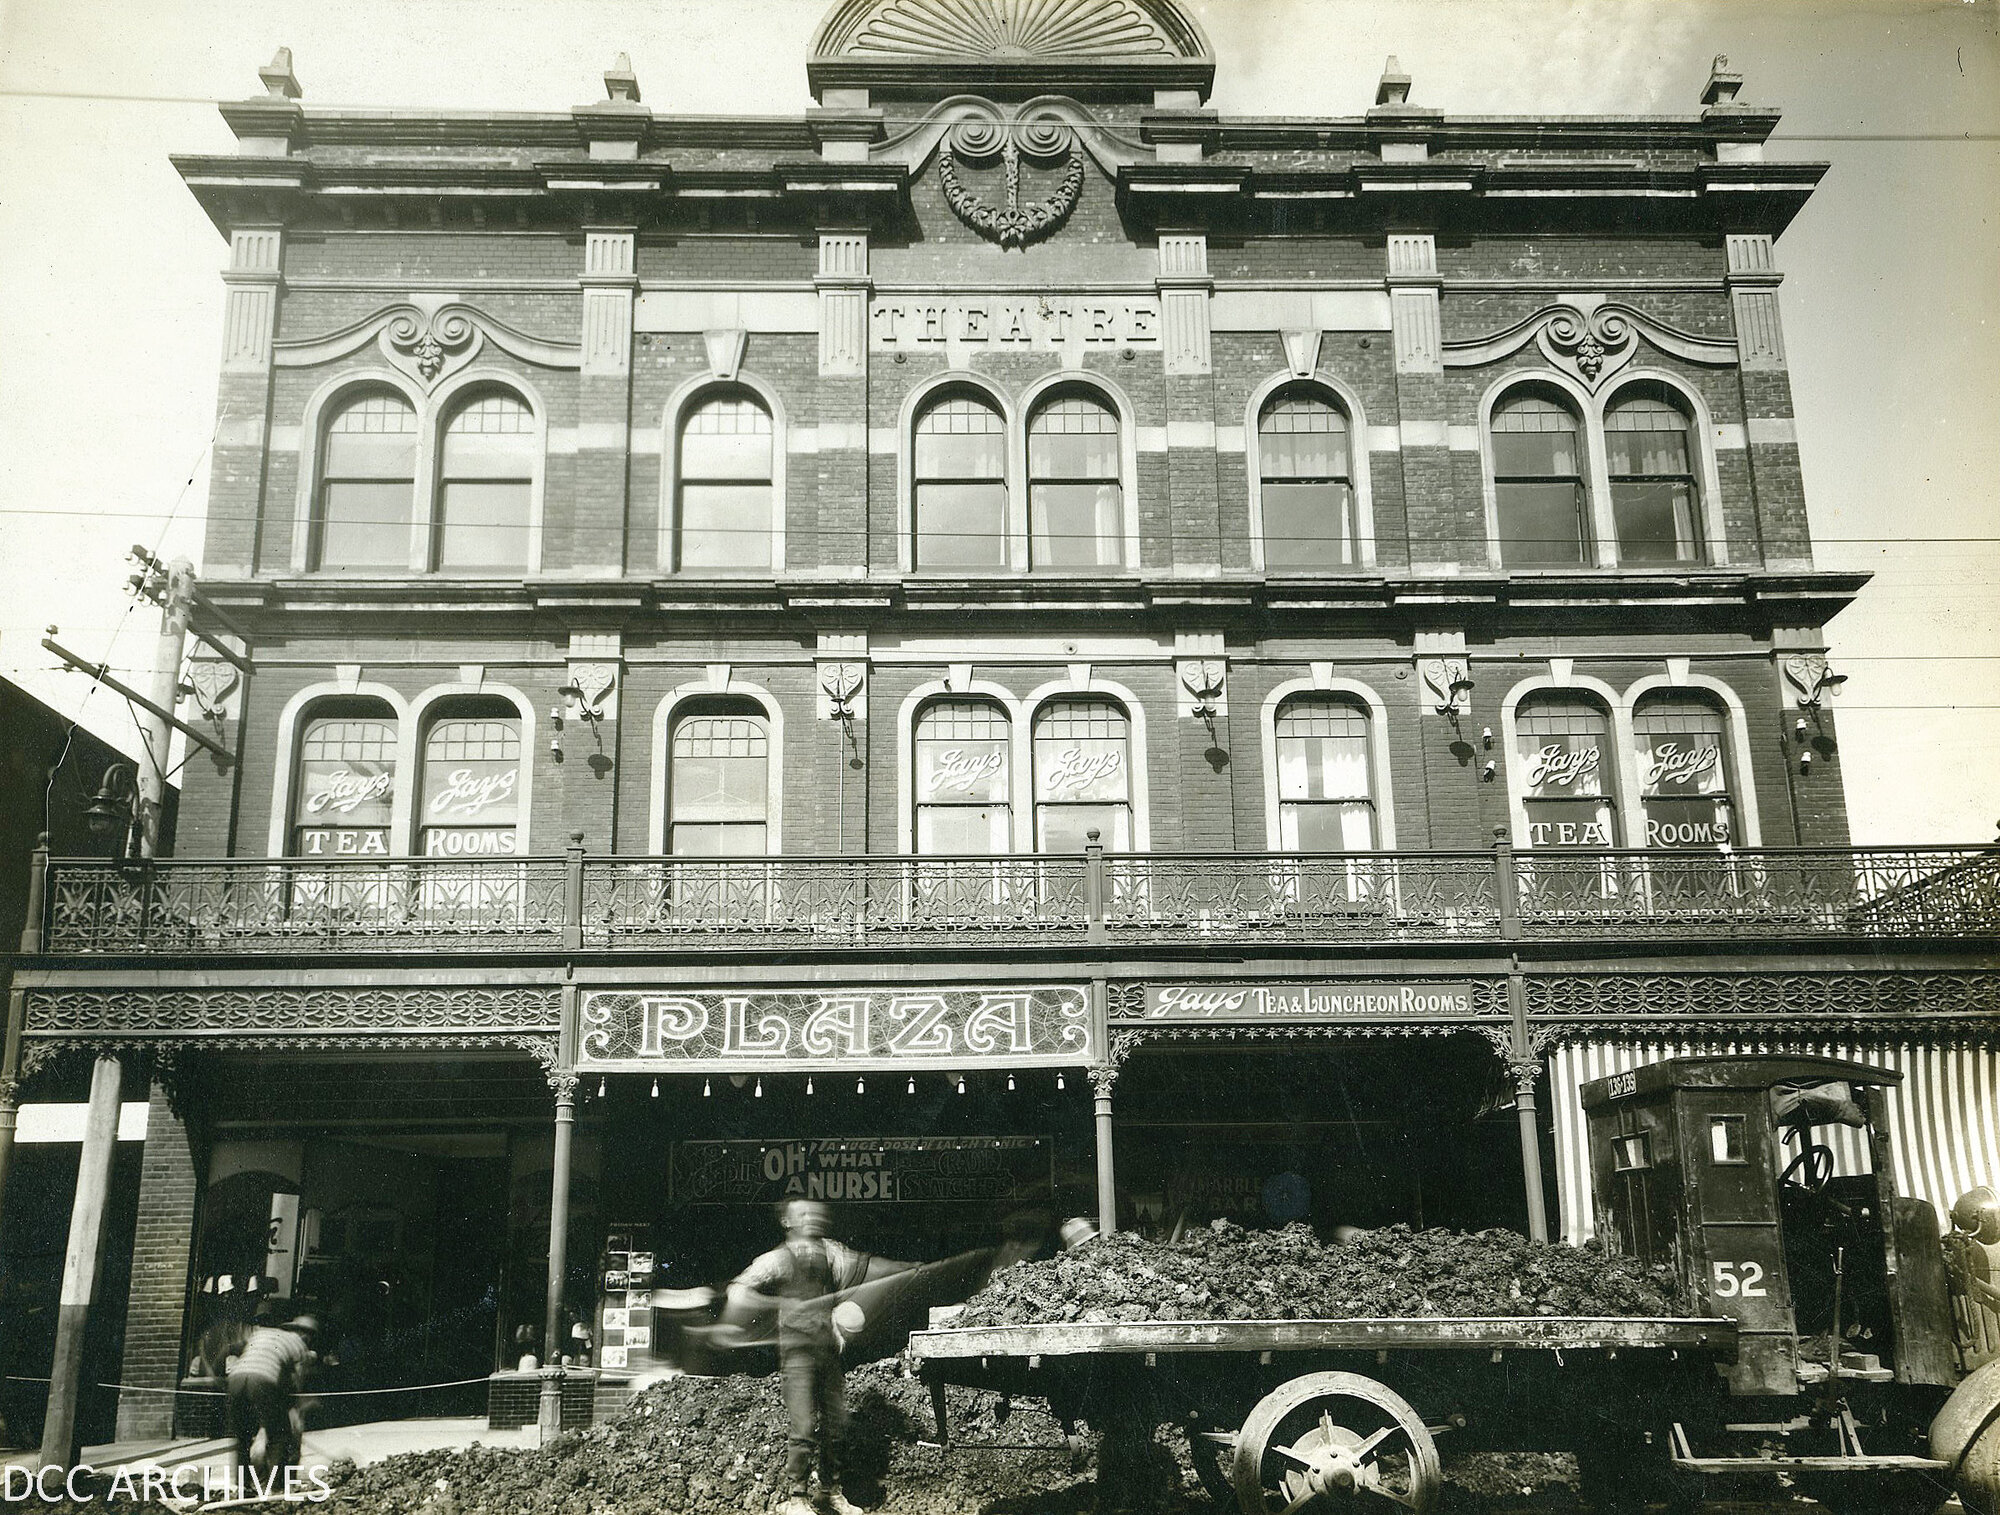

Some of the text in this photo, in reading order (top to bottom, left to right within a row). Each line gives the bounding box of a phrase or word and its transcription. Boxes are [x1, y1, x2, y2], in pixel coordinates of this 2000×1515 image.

[873, 307, 1157, 342] THEATRE
[305, 831, 390, 855] TEA
[1530, 821, 1609, 846] TEA
[638, 994, 1033, 1056] PLAZA
[817, 1151, 886, 1168] WHAT
[784, 1171, 893, 1200] A NURSE
[1714, 1261, 1767, 1299] 52
